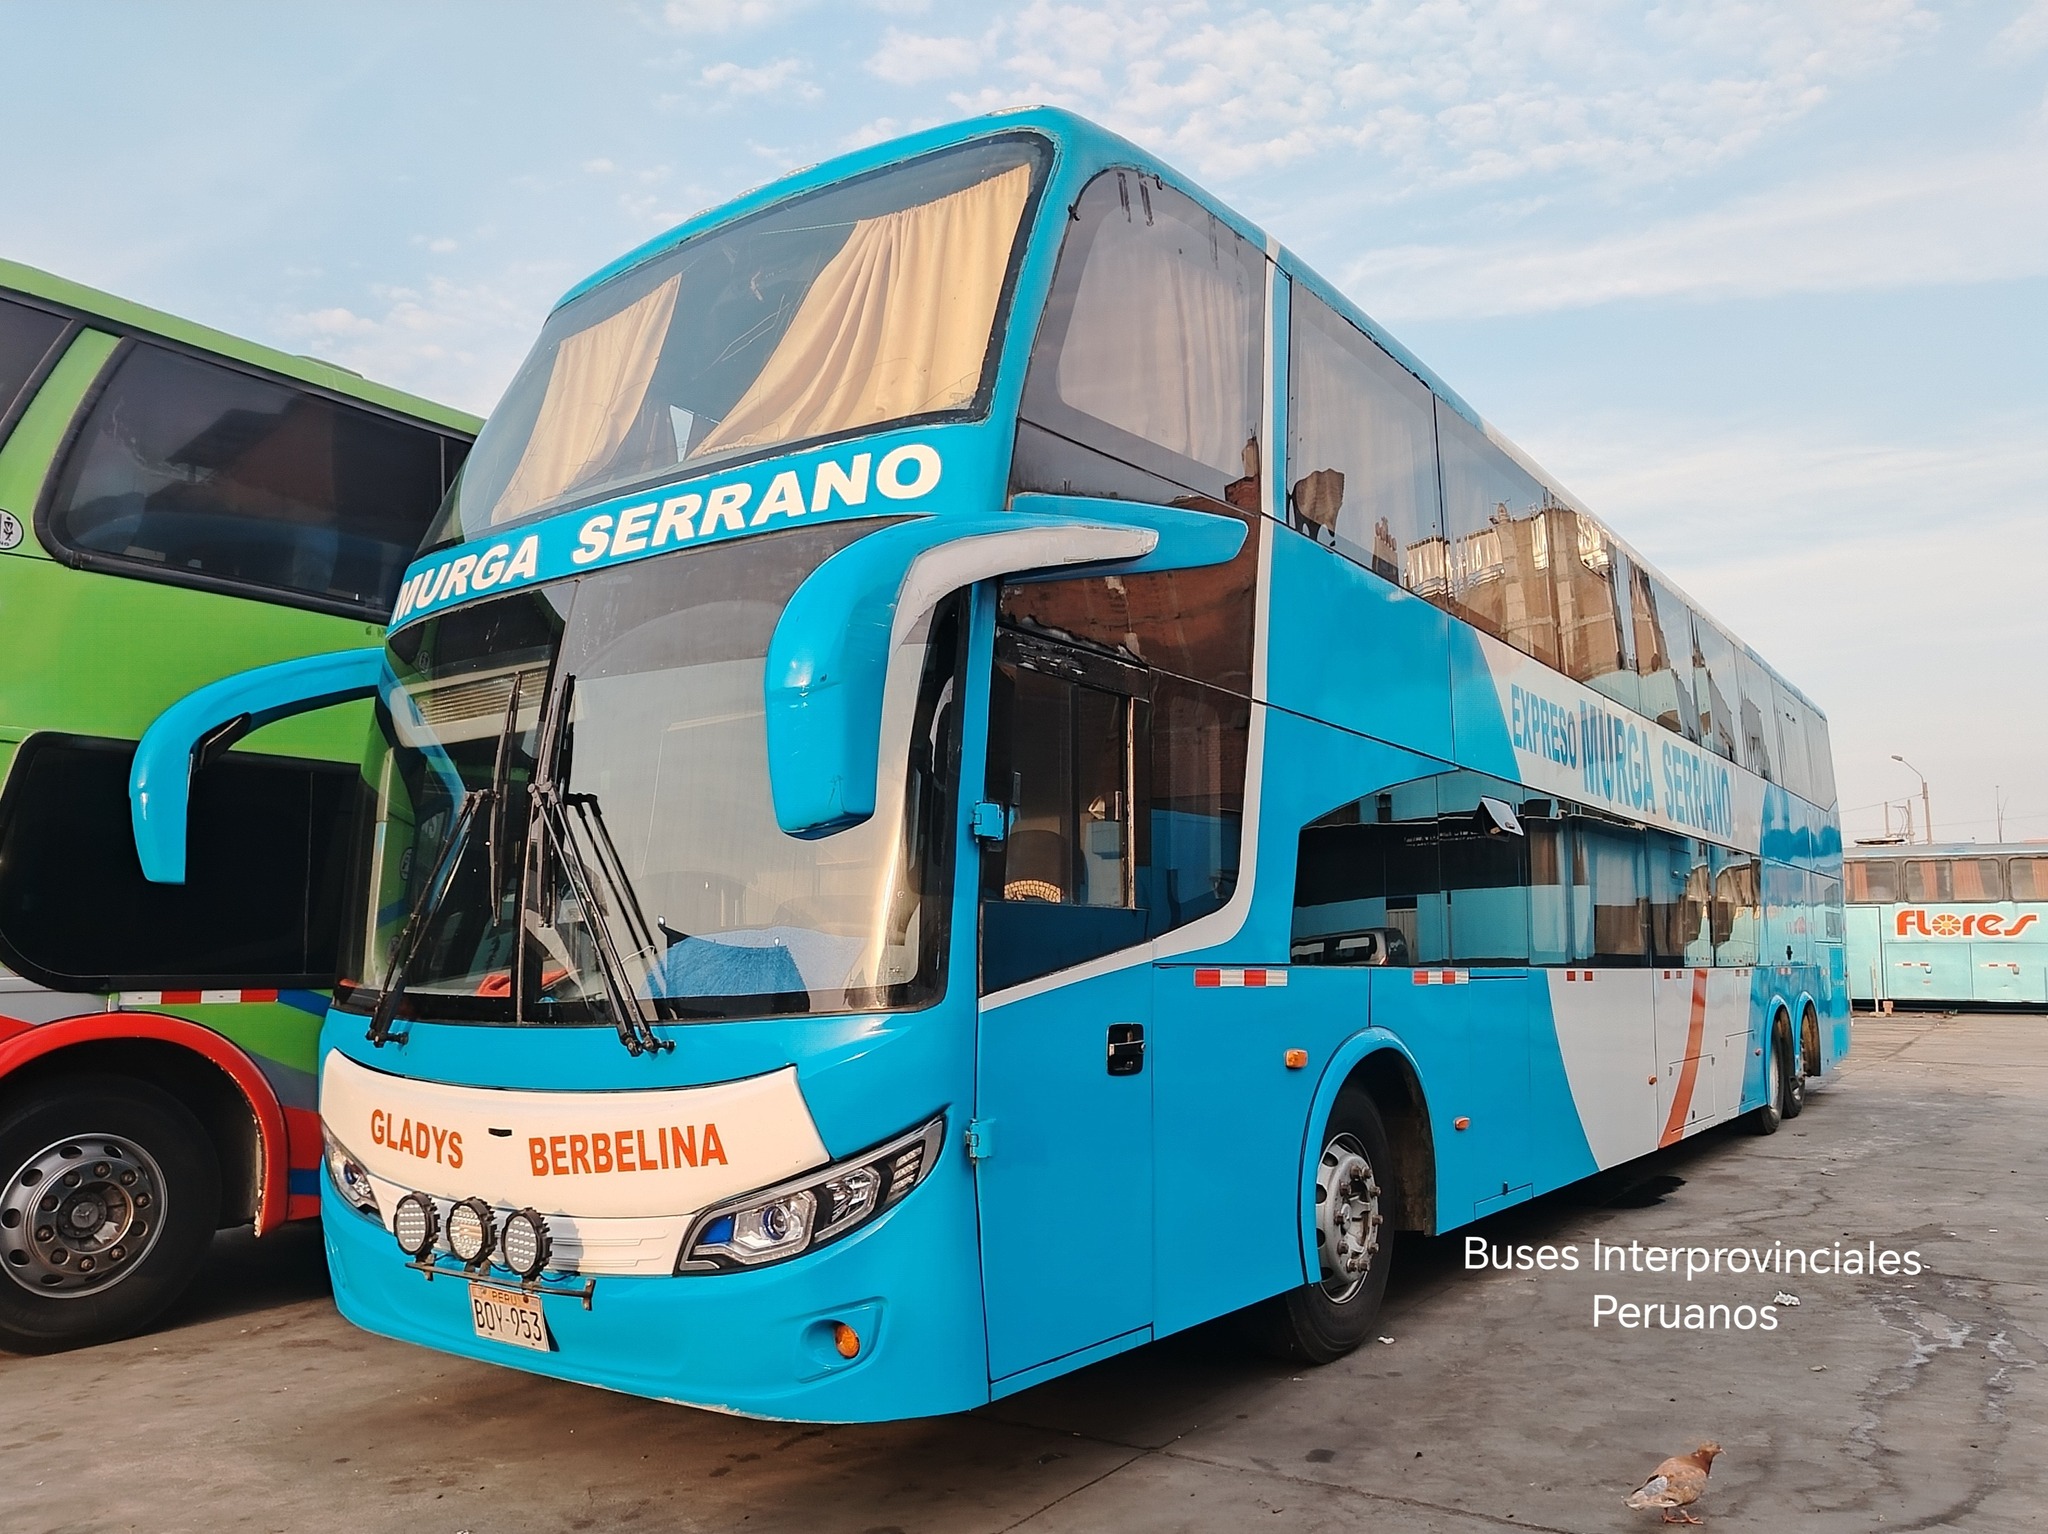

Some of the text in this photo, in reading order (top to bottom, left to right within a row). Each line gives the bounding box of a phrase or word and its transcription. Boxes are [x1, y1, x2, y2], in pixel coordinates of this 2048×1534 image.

[391, 443, 943, 626] MURGA SERRANO
[1510, 683, 1733, 840] EXPRESO MURGA SERRANO
[370, 1108, 729, 1177] GLADYS BERBELINA
[491, 1290, 518, 1306] PERU
